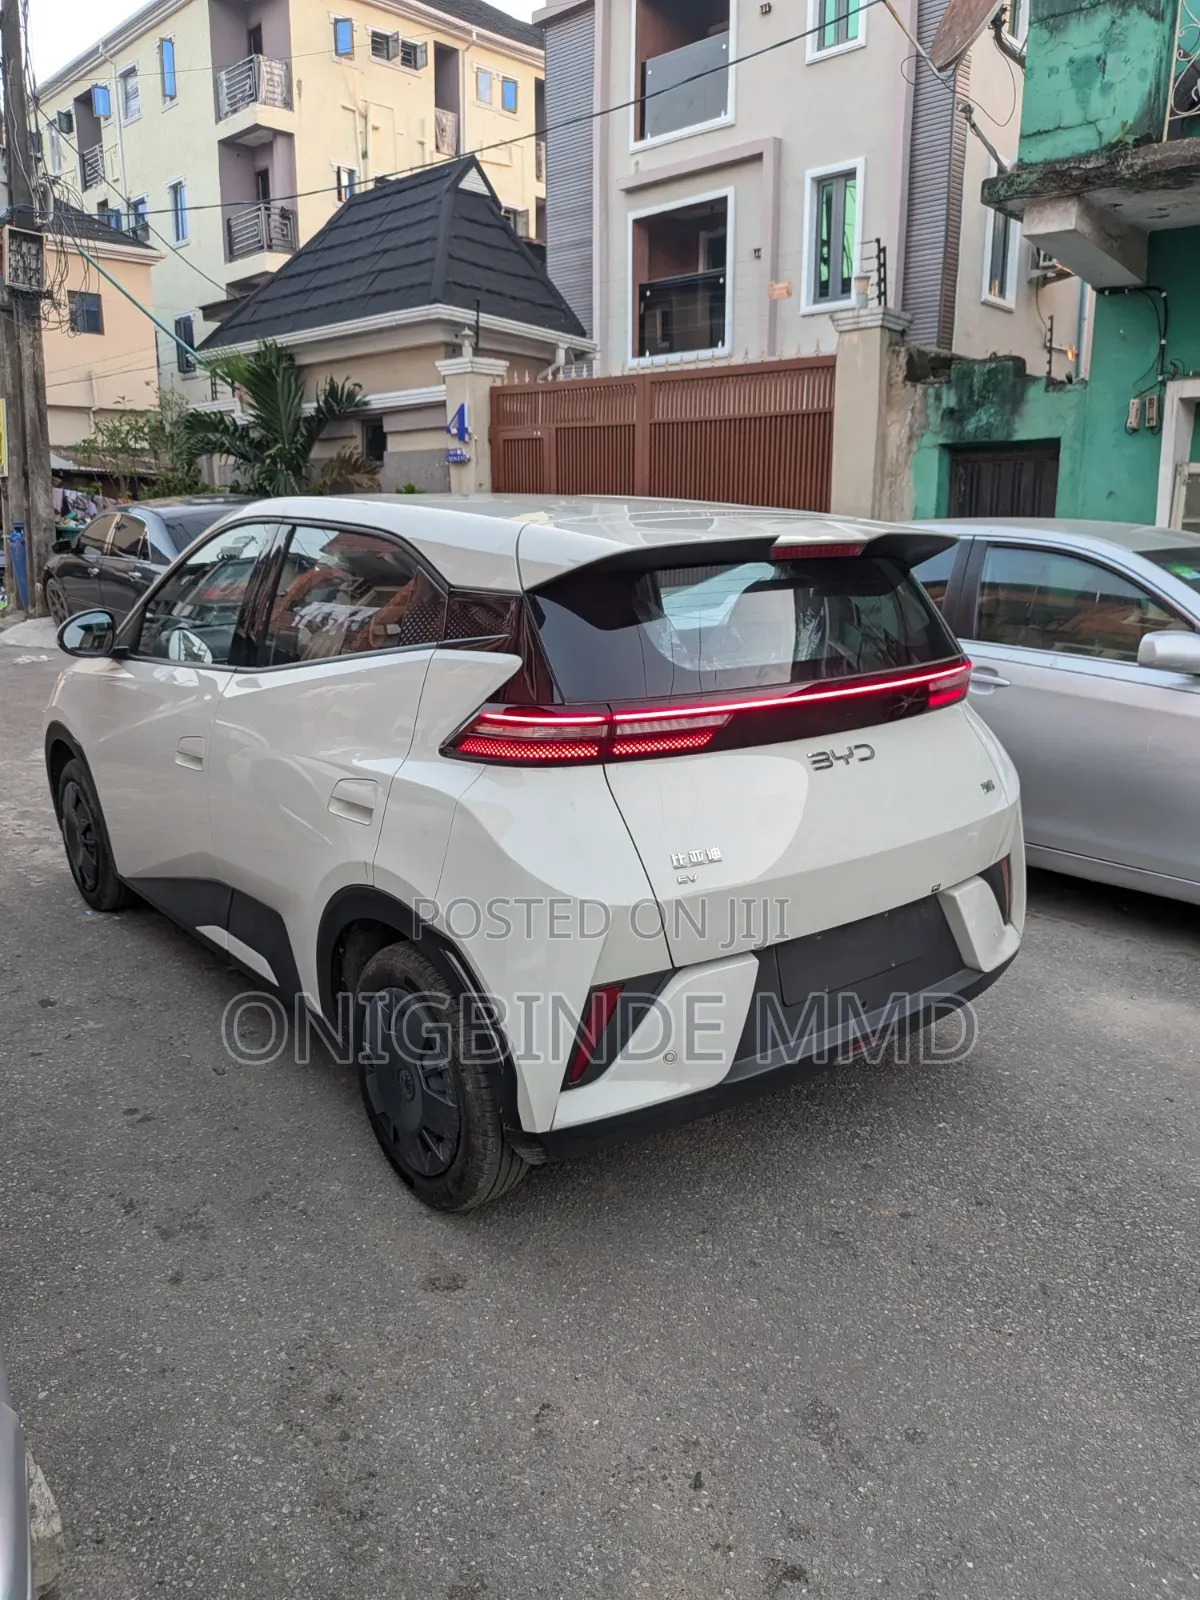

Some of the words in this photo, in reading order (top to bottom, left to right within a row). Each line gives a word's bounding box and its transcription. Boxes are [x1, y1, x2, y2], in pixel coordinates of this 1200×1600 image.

[446, 403, 468, 442] 4
[807, 743, 876, 771] BYD
[670, 847, 722, 869] 比亚迪
[677, 873, 699, 885] EV
